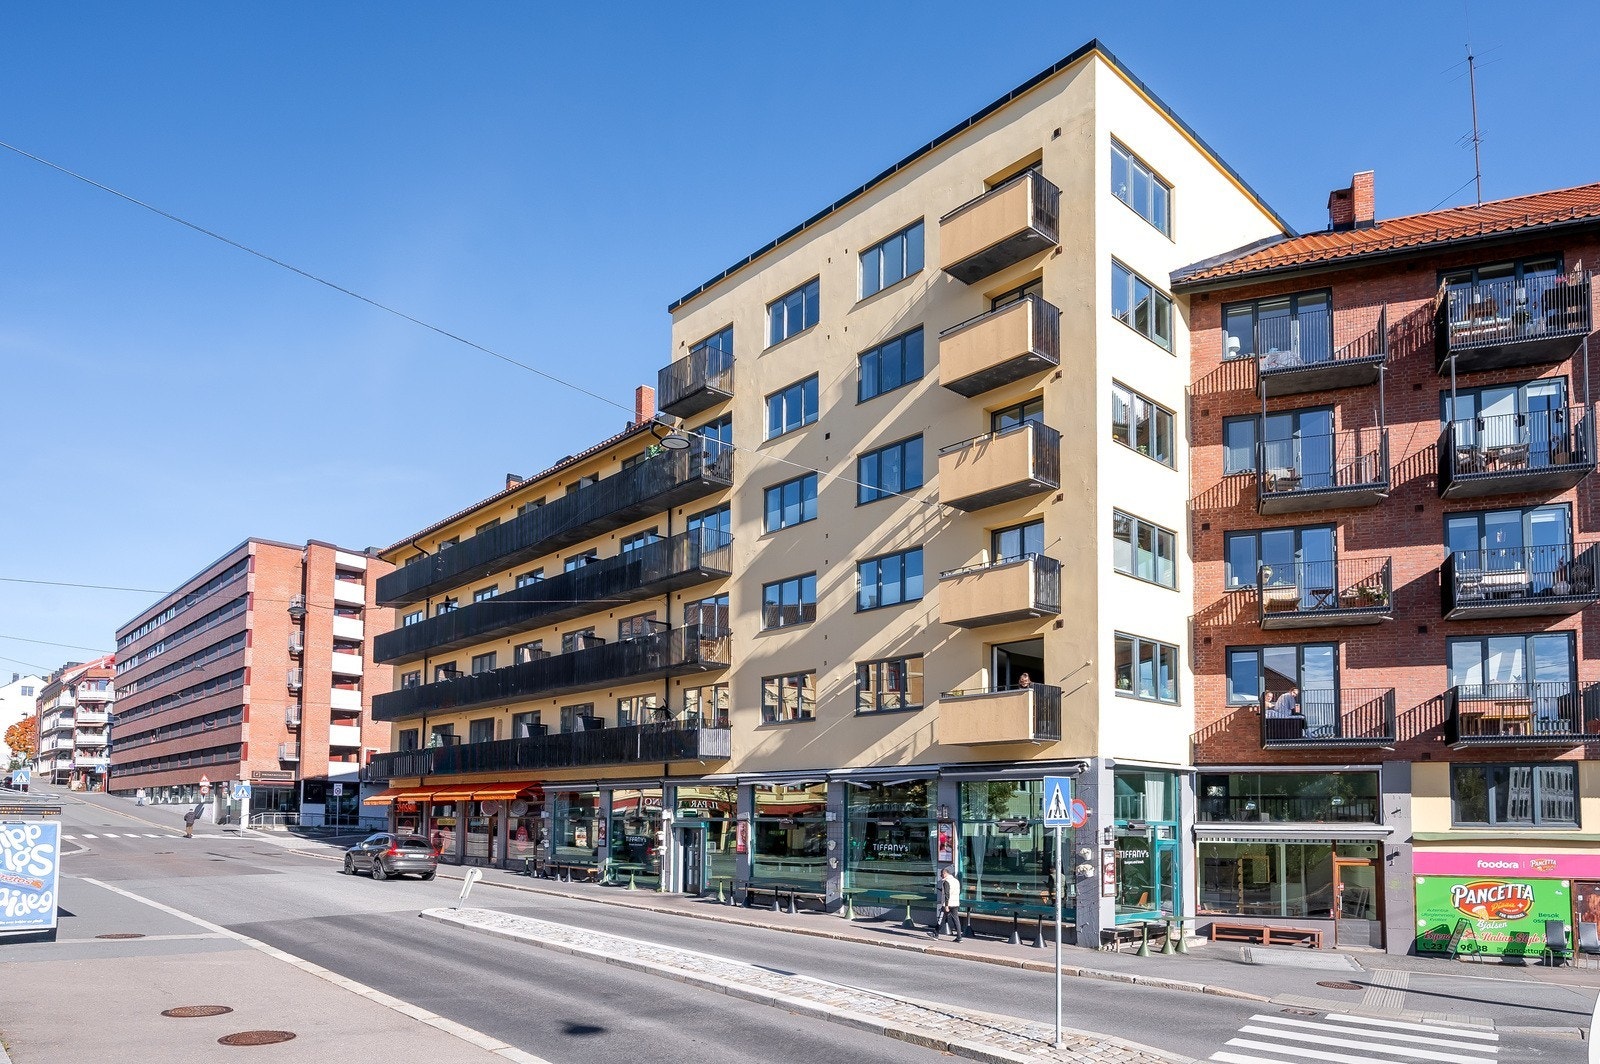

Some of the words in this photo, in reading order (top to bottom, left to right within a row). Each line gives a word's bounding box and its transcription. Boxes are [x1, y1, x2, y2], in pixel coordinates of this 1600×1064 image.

[1477, 859, 1519, 869] foodora
[1530, 859, 1557, 868] PANCETTA
[1450, 883, 1535, 908] PANCETTA
